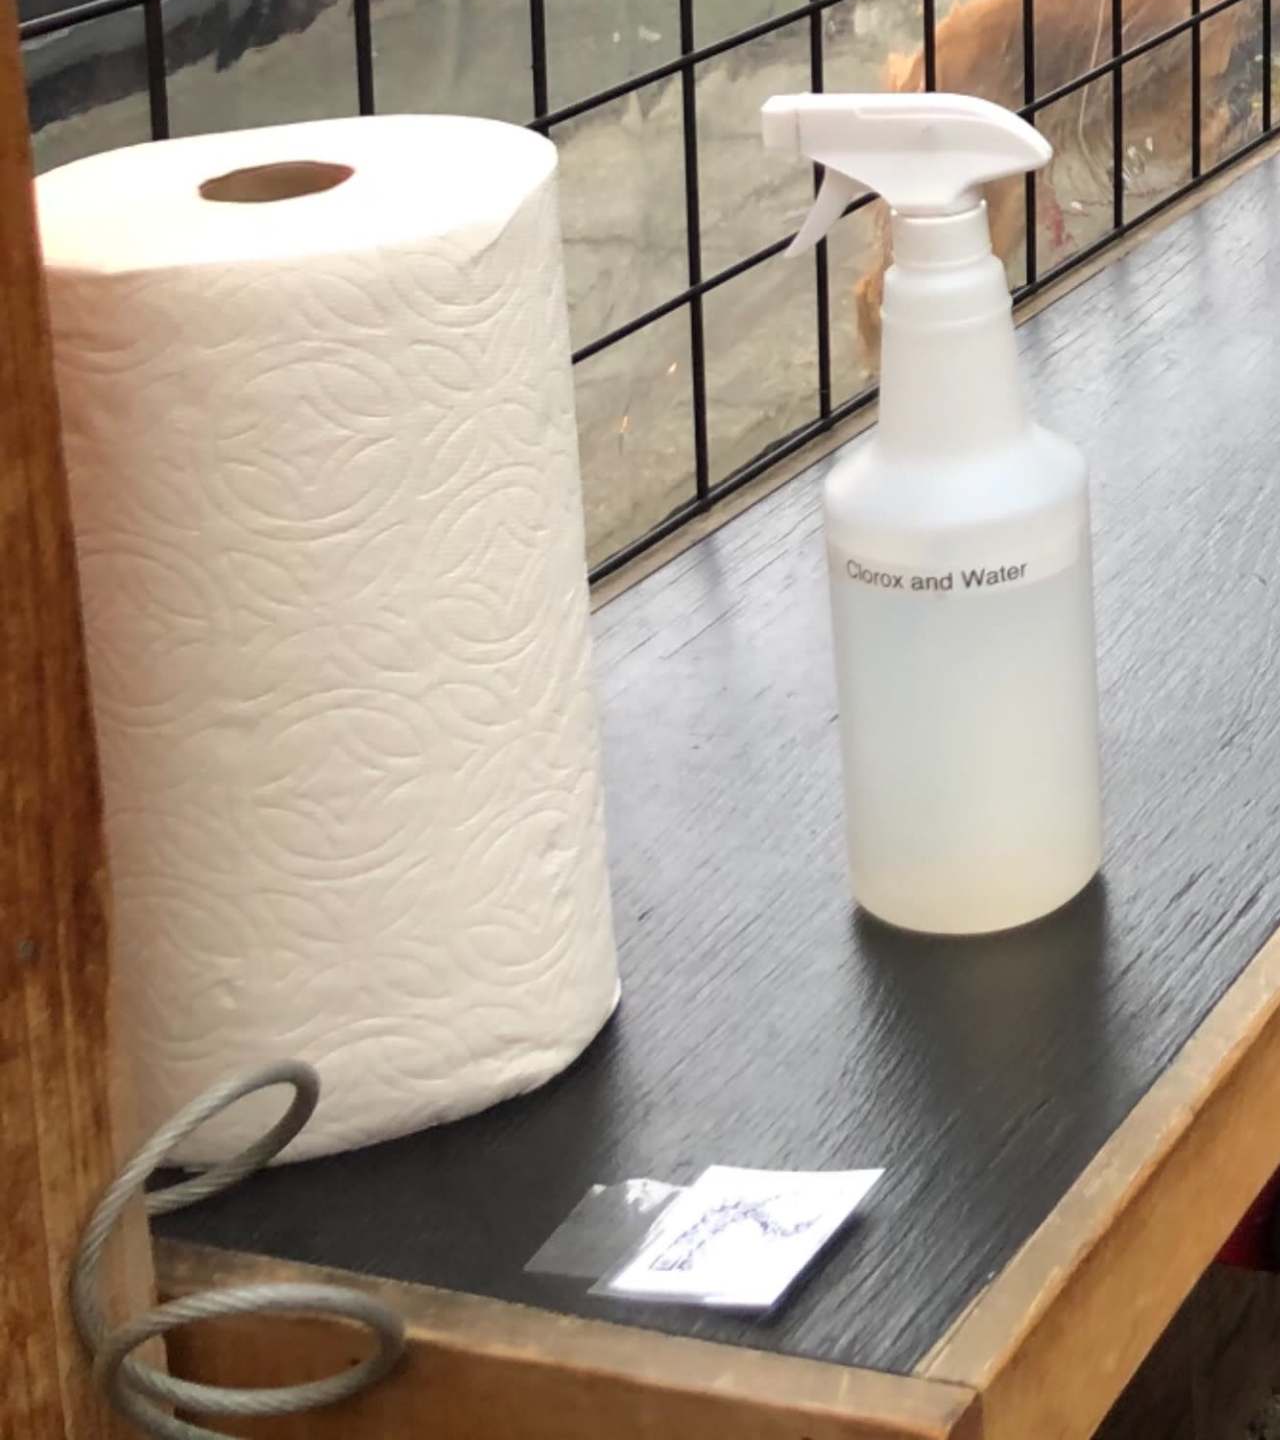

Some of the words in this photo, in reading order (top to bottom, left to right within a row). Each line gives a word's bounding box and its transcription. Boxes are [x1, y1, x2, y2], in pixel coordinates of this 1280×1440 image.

[846, 559, 905, 589] Clorox
[911, 572, 953, 591] and
[961, 562, 1027, 589] Water
